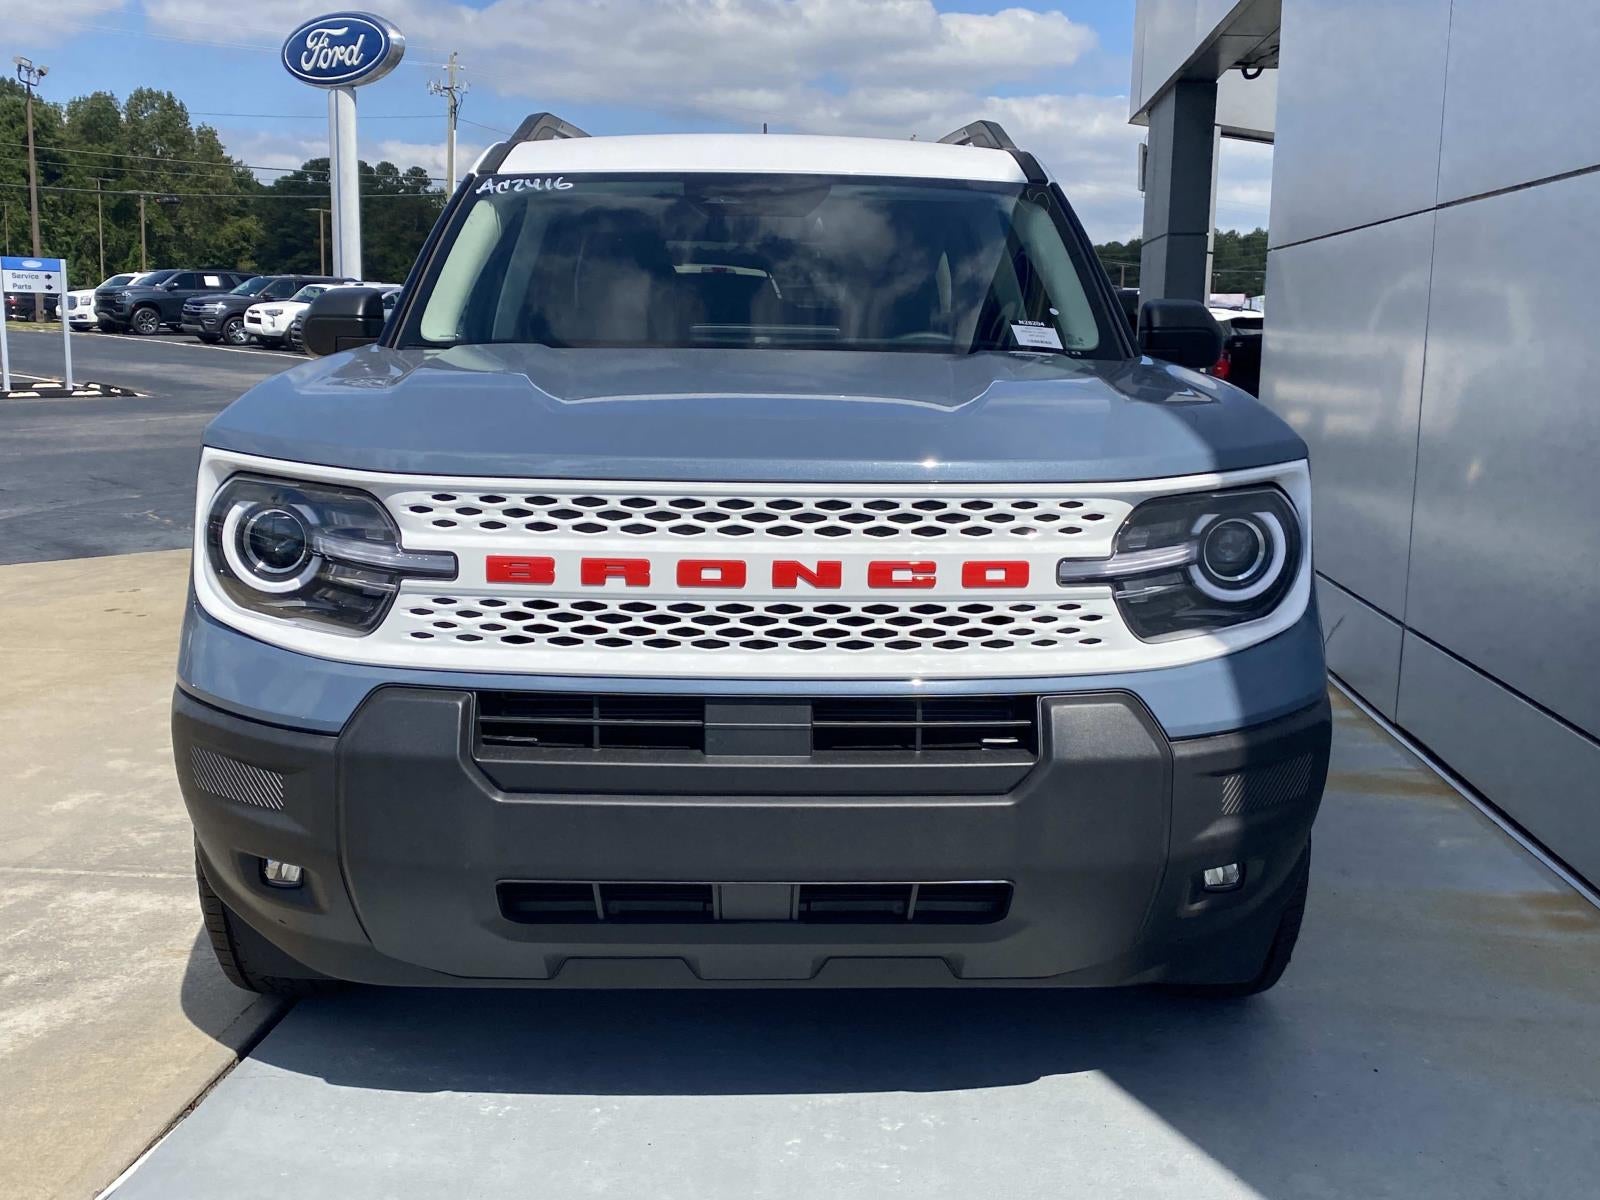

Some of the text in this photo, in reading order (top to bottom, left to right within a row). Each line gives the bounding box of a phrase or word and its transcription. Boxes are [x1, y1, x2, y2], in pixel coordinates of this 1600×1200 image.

[301, 26, 365, 72] Ford
[11, 272, 40, 280] Service
[12, 282, 32, 290] Parts
[486, 555, 1030, 589] BRONCO
